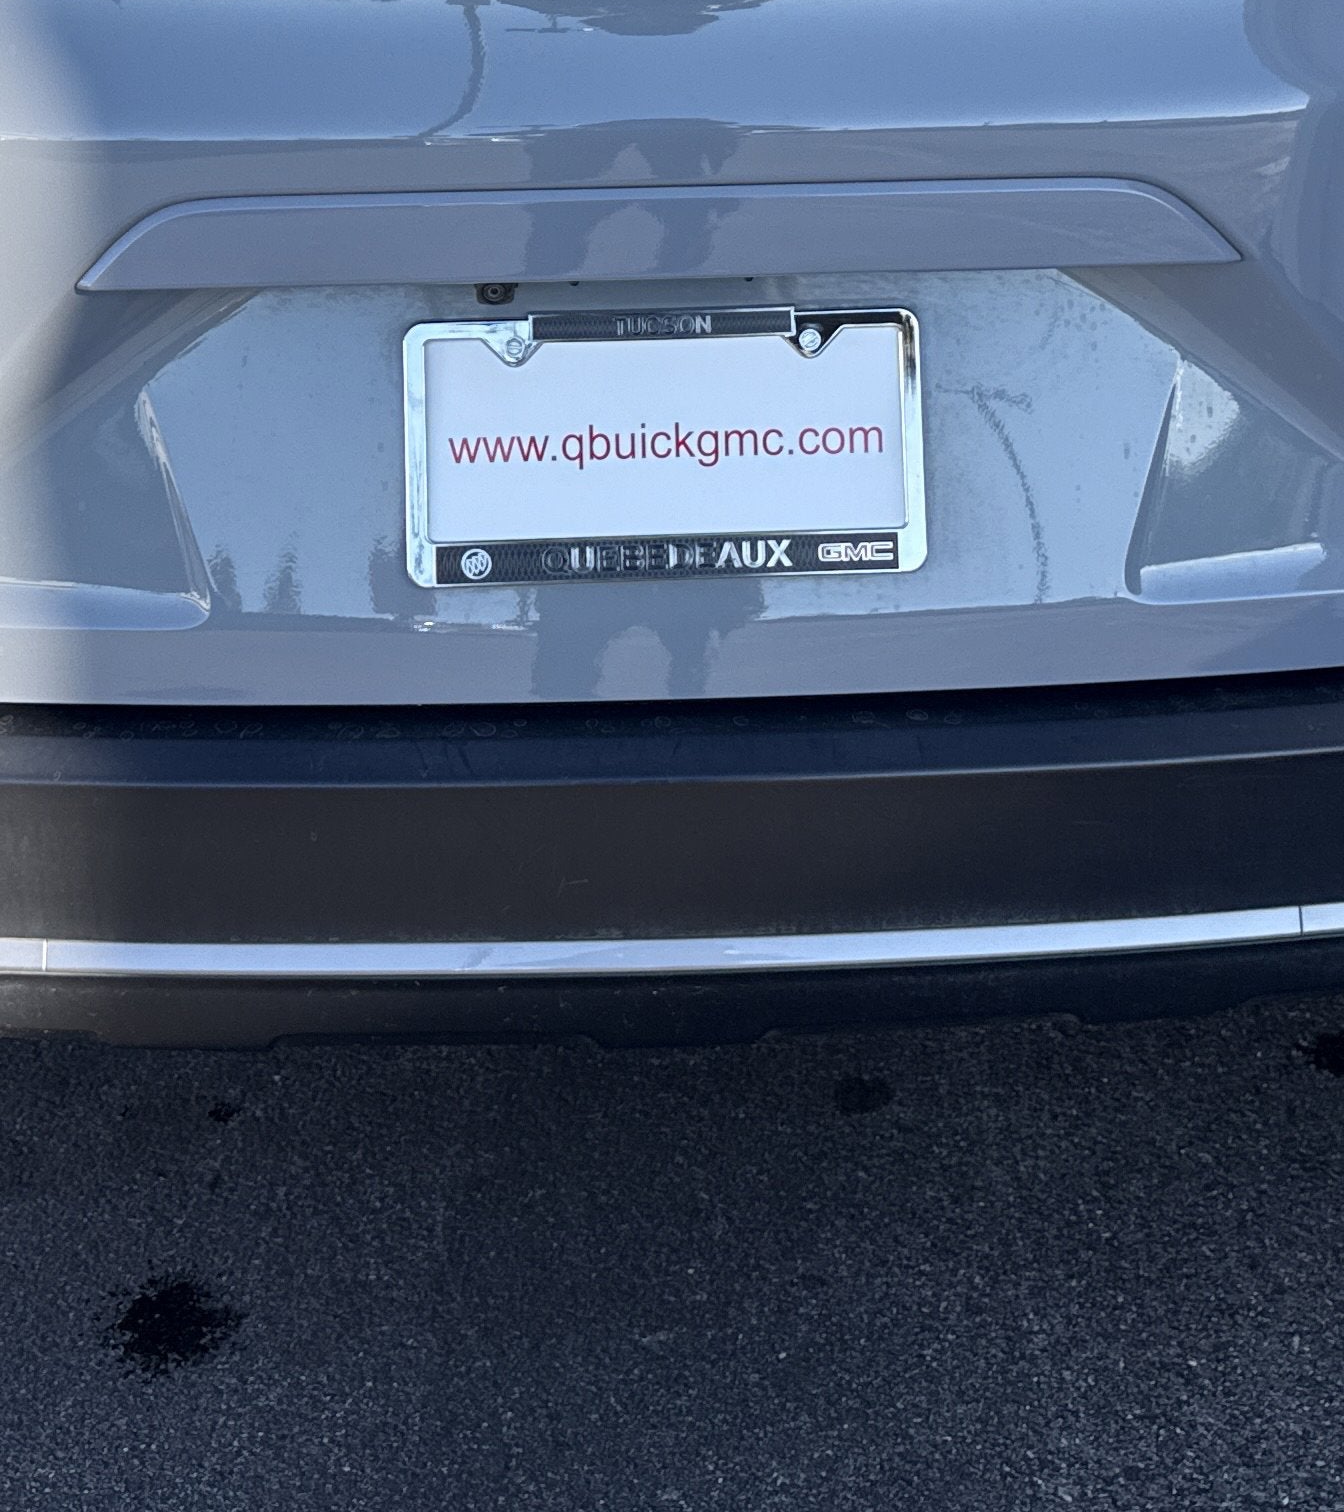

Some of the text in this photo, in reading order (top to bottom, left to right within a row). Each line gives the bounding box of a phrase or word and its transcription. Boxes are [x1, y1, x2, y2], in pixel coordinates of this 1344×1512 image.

[613, 314, 713, 336] TUCSON
[448, 422, 884, 470] www.qbuickgmc.com
[542, 538, 894, 574] QUEBEDEAUX GMC
